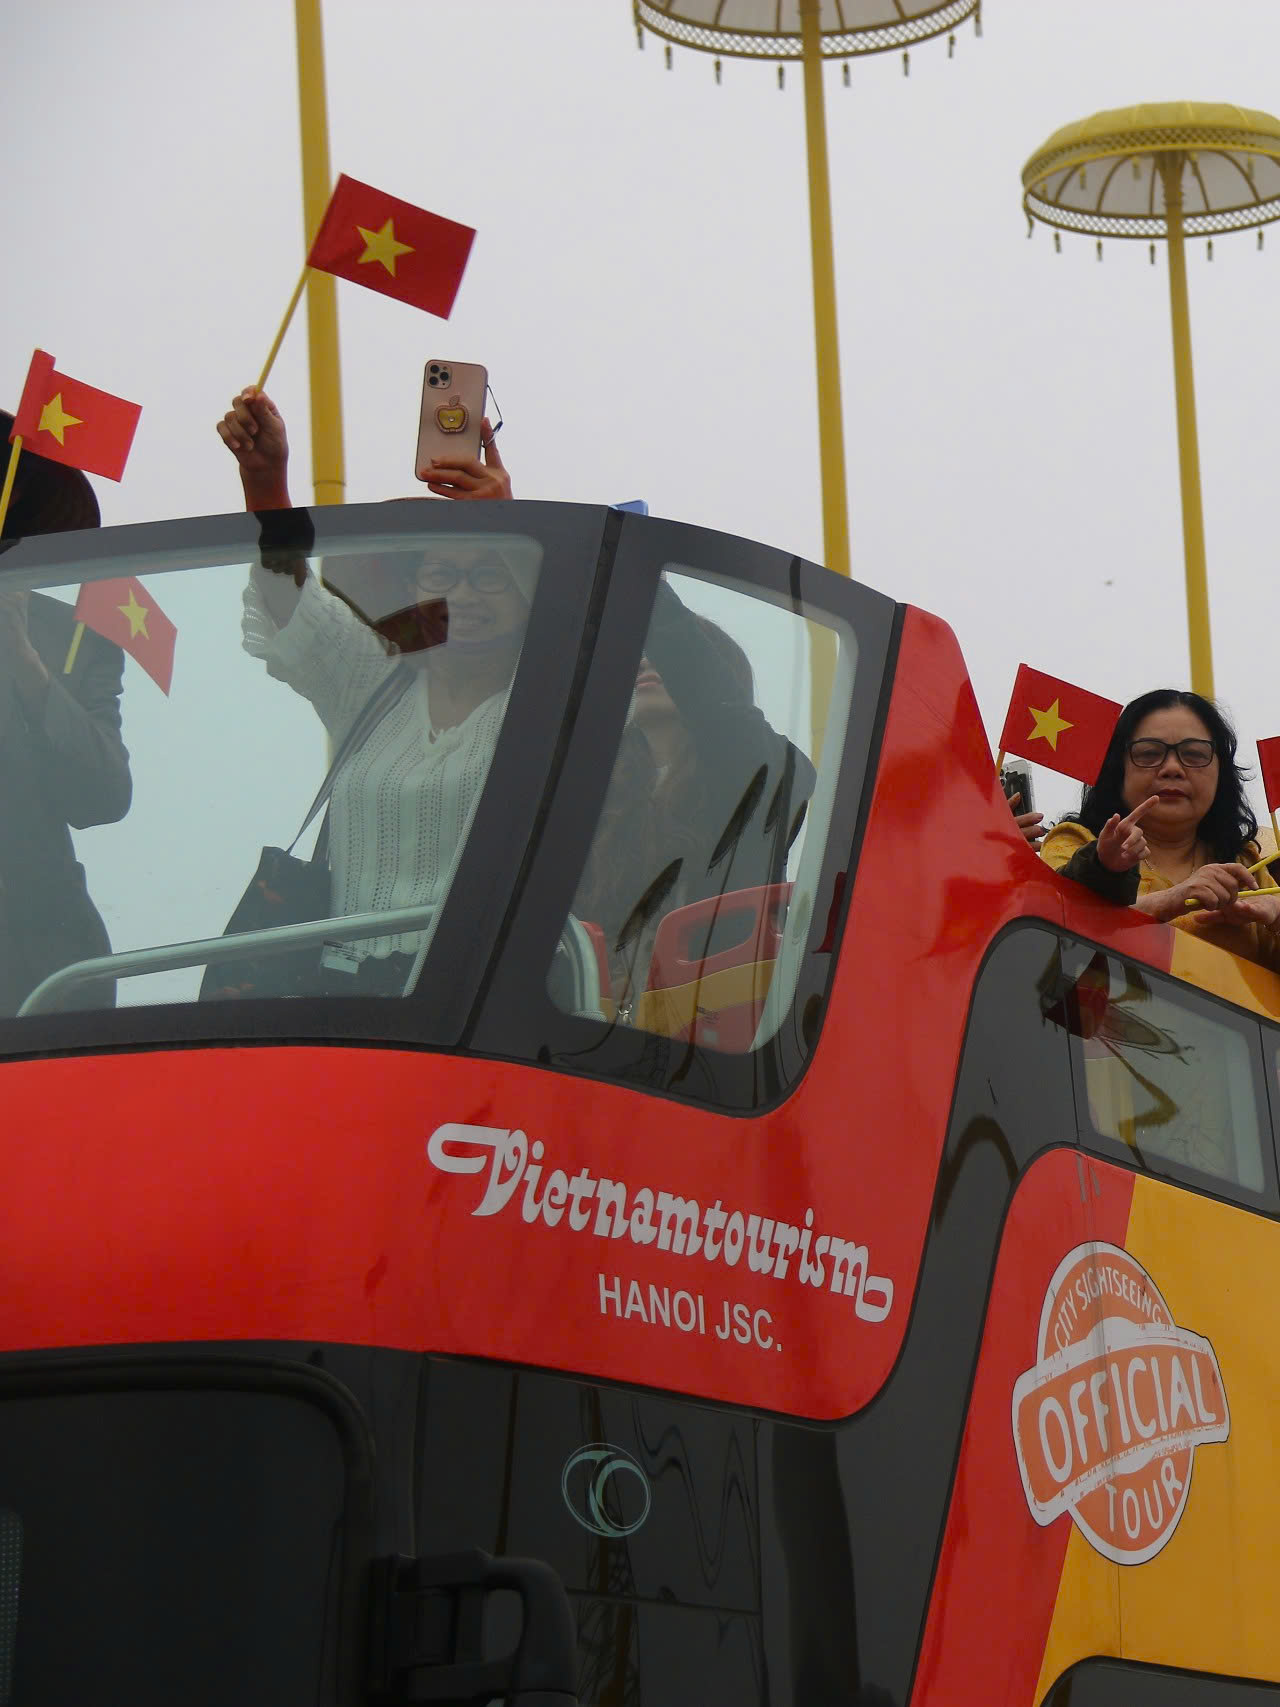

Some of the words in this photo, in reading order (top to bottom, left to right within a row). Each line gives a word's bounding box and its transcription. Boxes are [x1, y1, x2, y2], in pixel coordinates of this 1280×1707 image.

[427, 1122, 894, 1323] Vietnamtourism
[598, 1272, 706, 1336] HANOI
[714, 1300, 783, 1353] JSC.
[1054, 1287, 1079, 1350] CITY
[1075, 1265, 1163, 1326] SIGHTSEEING
[1038, 1353, 1218, 1484] OFFICIAL
[1104, 1457, 1184, 1540] TOUR
